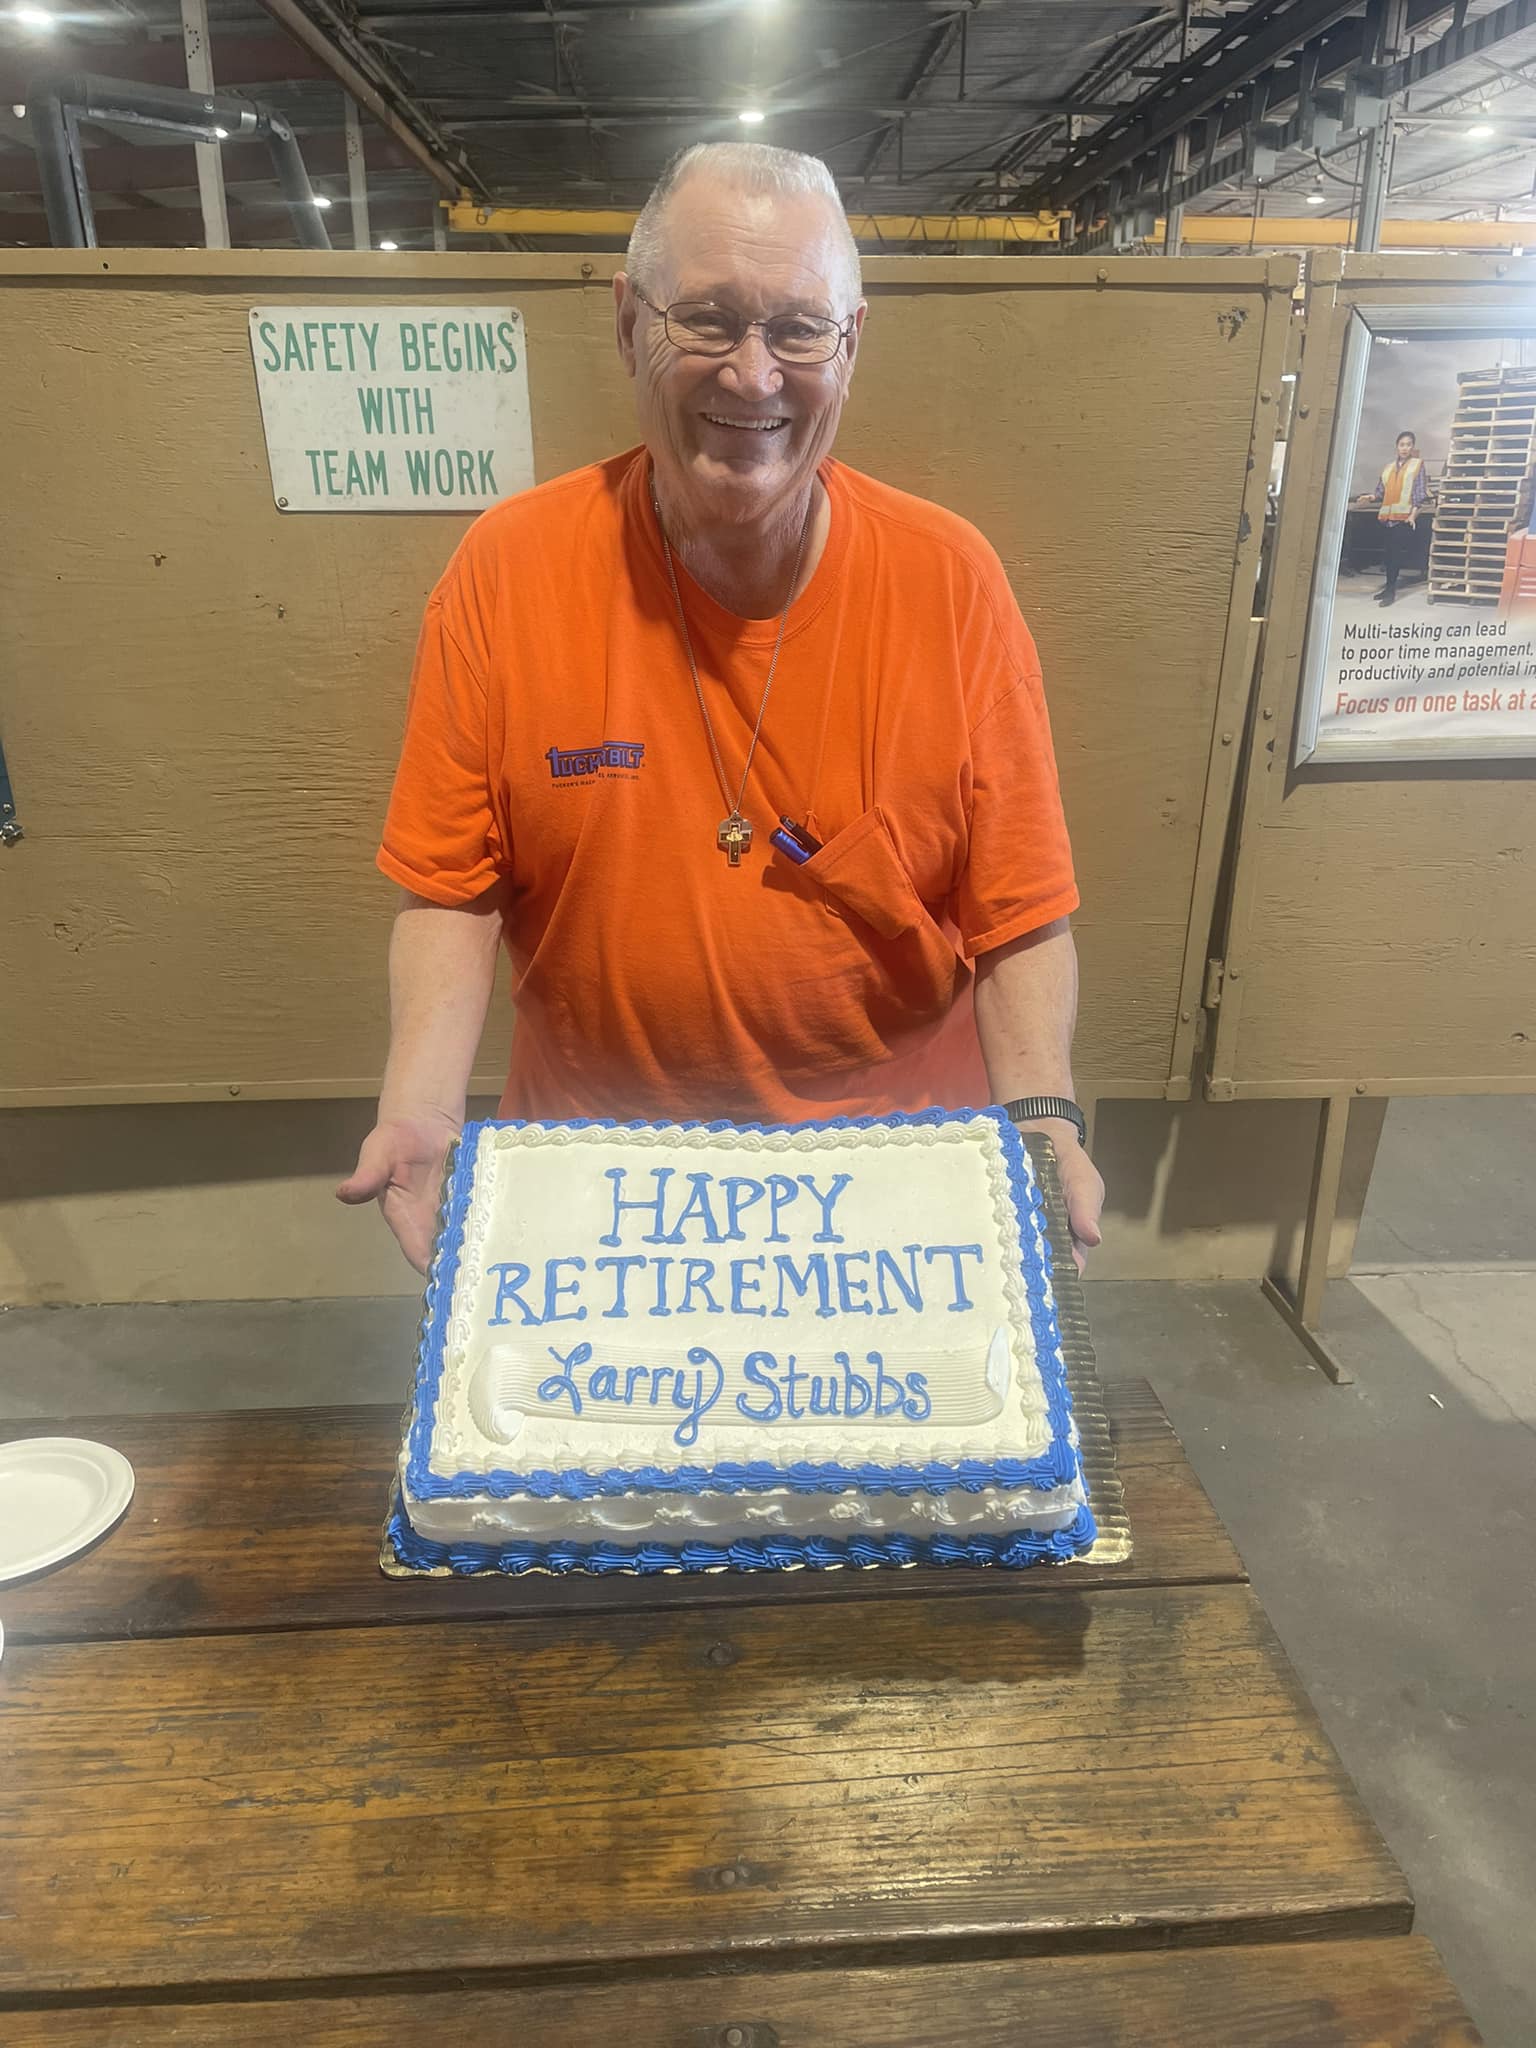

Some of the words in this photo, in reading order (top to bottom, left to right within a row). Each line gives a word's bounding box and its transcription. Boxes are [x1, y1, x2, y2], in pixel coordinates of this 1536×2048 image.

[259, 321, 379, 372] SAFETY
[399, 321, 518, 373] BEGINS
[357, 387, 435, 434] WITH
[305, 450, 389, 496] TEAM
[405, 449, 499, 496] WORK
[1341, 645, 1355, 660] to
[1359, 648, 1394, 664] poor
[1398, 644, 1430, 659] time
[1434, 642, 1534, 661] management.
[1343, 622, 1442, 641] Multi-tasking
[1446, 624, 1471, 637] can
[1475, 621, 1507, 637] lead
[1338, 664, 1424, 684] productivity
[1428, 663, 1455, 679] and
[1457, 661, 1520, 680] potential
[1335, 692, 1389, 715] Focus
[1394, 695, 1417, 713] on
[1423, 694, 1457, 713] one
[1463, 688, 1502, 711] task
[1507, 688, 1526, 711] at
[599, 1167, 853, 1247] HAPPY
[487, 1244, 983, 1327] RETIREMENT
[537, 1342, 724, 1447] Larry
[736, 1350, 931, 1421] Stubbs
